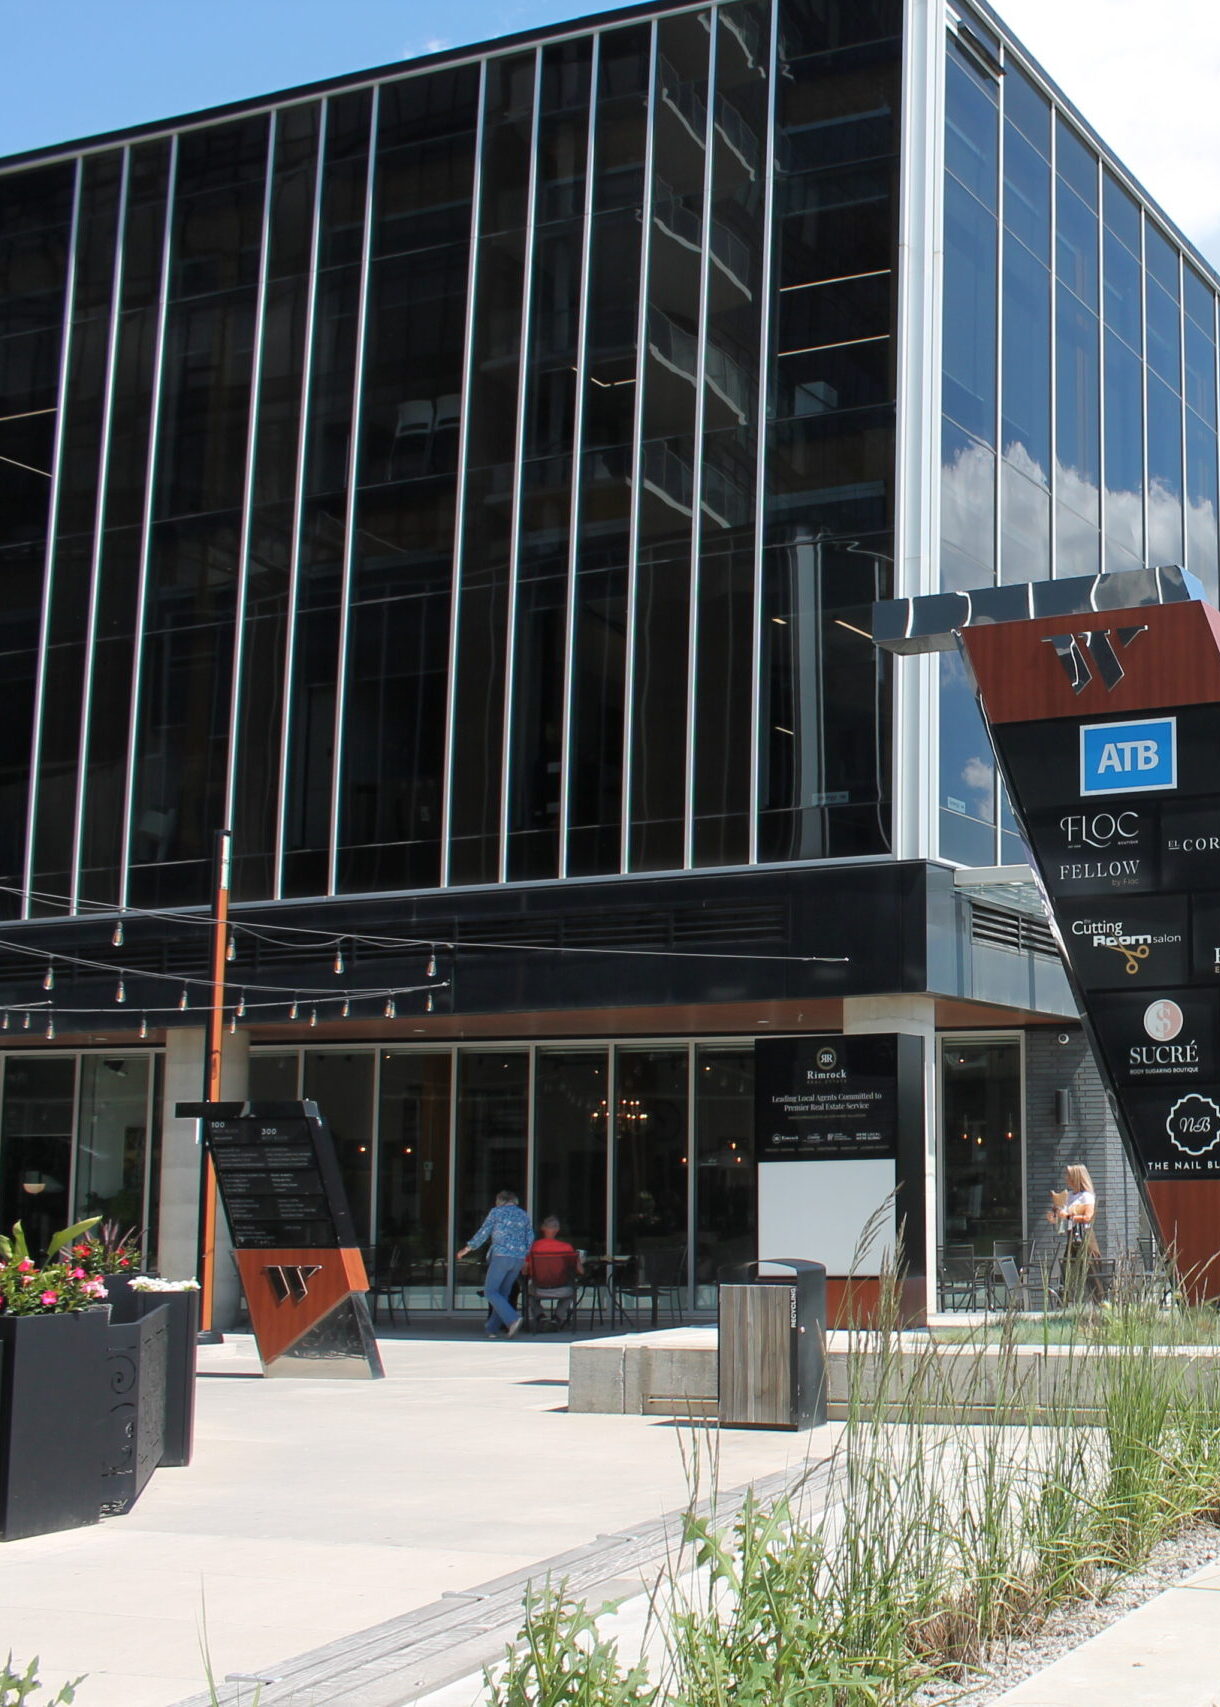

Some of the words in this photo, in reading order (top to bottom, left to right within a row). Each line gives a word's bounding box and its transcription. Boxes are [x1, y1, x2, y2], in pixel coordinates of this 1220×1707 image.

[1097, 739, 1159, 774] ATB
[1060, 811, 1139, 848] FLOC
[1168, 840, 1180, 849] EL
[1059, 859, 1140, 880] FELLOW
[1072, 920, 1123, 936] Cutting
[1093, 935, 1152, 947] Room
[1153, 934, 1181, 943] salon
[1129, 1039, 1199, 1065] SUCRÉ
[807, 1069, 847, 1080] Rimrock
[1145, 1067, 1172, 1075] SUGARING
[1172, 1066, 1199, 1074] BOUTIQUE
[772, 1095, 797, 1104] Leading
[816, 1094, 837, 1103] Agents
[838, 1092, 874, 1101] Committed
[875, 1092, 882, 1100] to
[784, 1104, 809, 1112] Premier
[810, 1103, 825, 1111] Real
[826, 1102, 845, 1110] Estate
[846, 1101, 870, 1110] Service
[211, 1121, 225, 1129] 100
[1148, 1161, 1169, 1171] THE
[1175, 1161, 1202, 1170] NAIL
